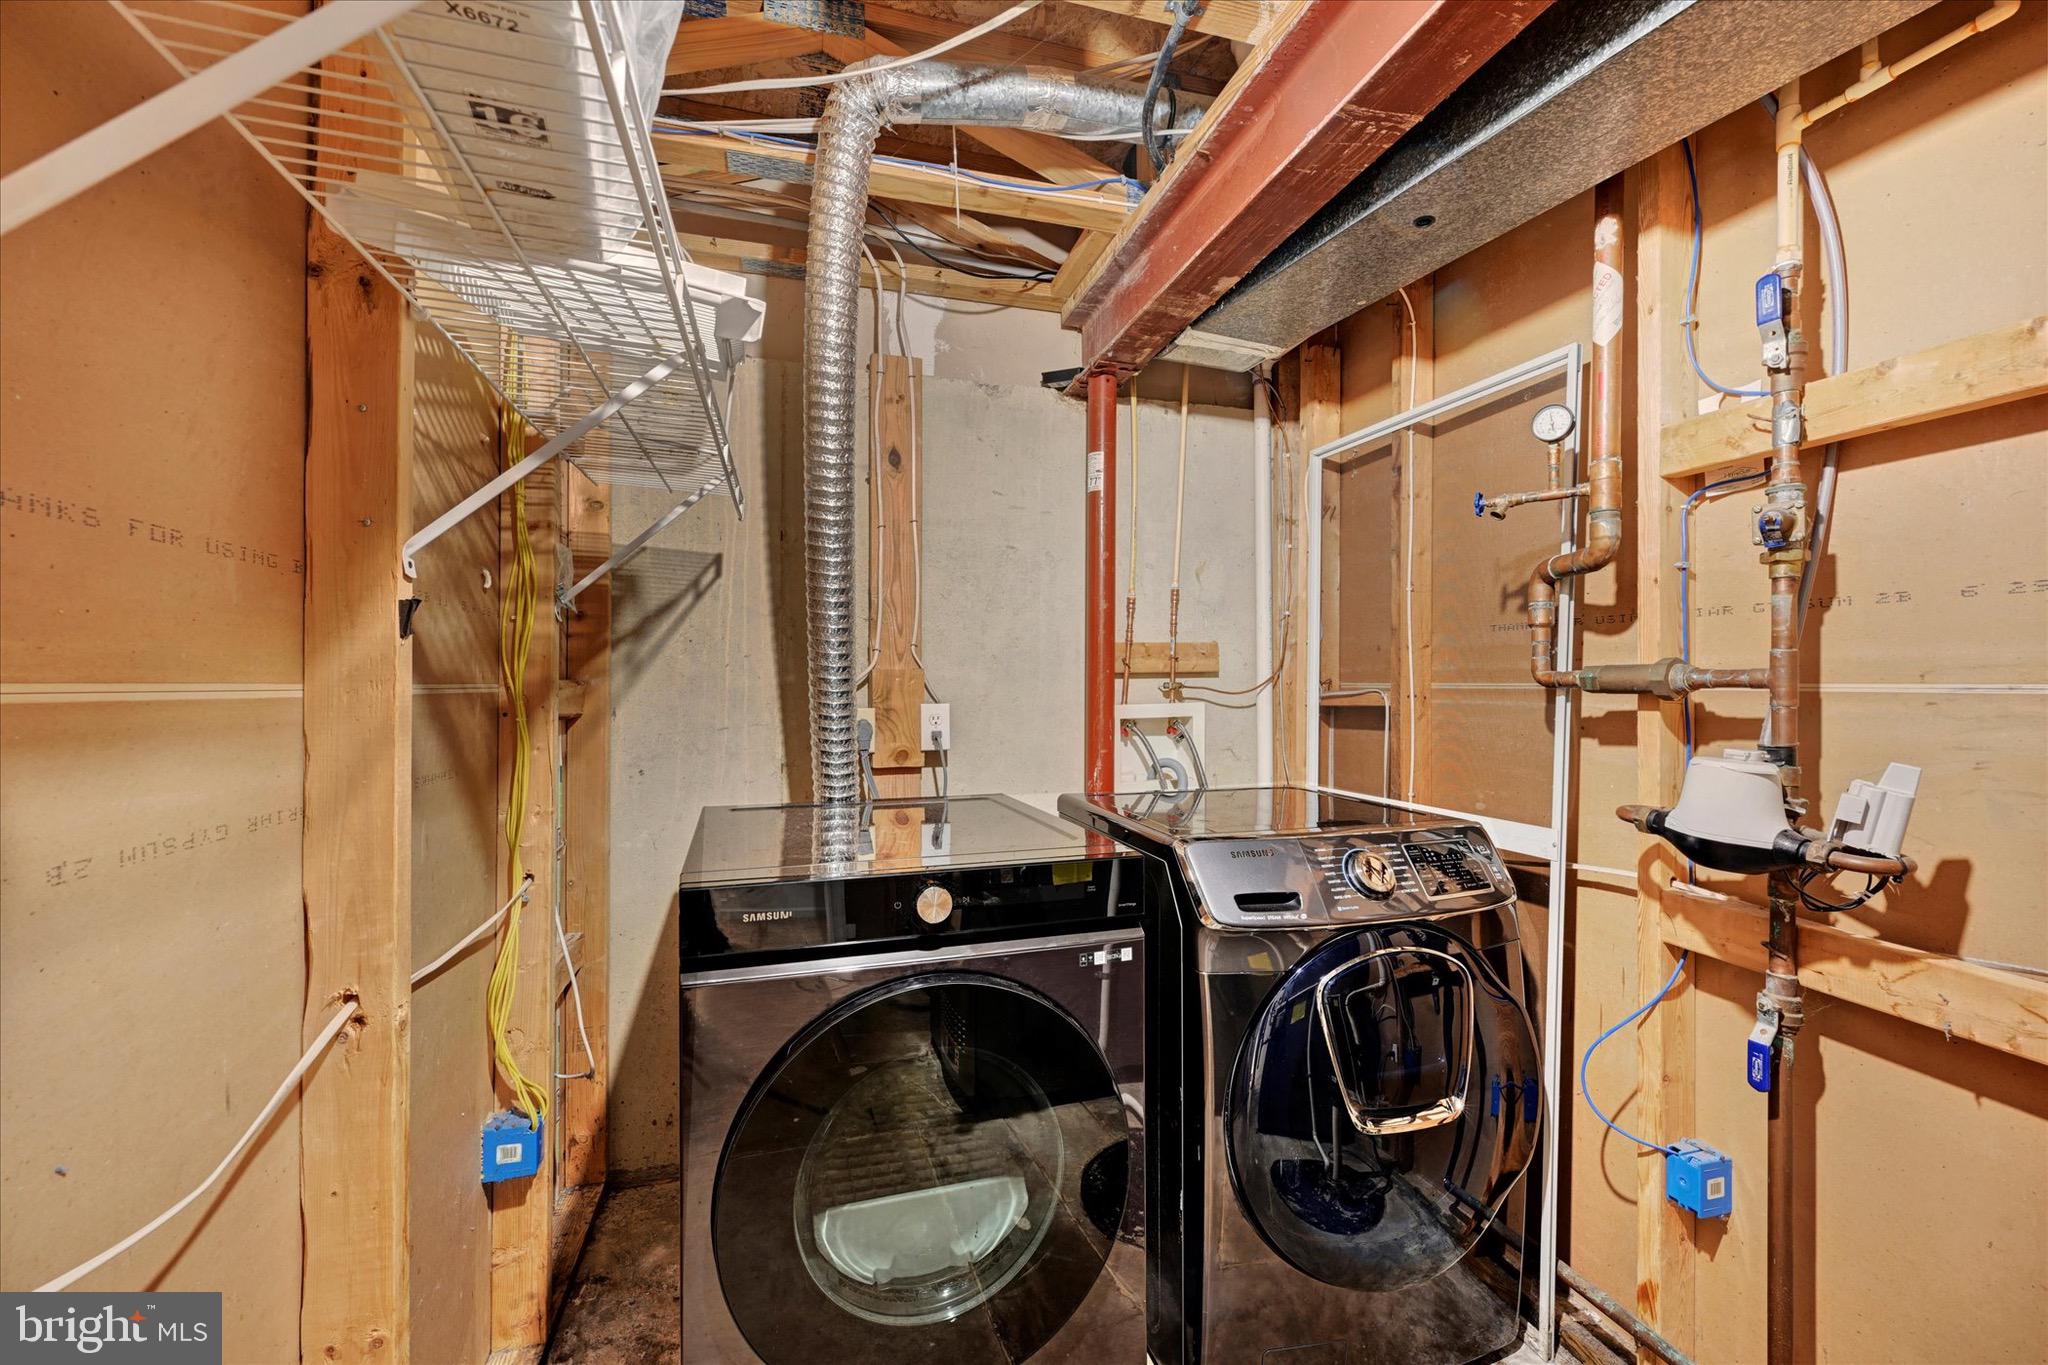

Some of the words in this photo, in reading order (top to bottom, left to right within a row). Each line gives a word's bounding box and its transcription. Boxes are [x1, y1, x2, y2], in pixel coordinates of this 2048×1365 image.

[445, 0, 521, 33] X6672
[129, 518, 184, 548] FOR
[206, 537, 278, 569] USING
[119, 823, 229, 869] GYPSUM
